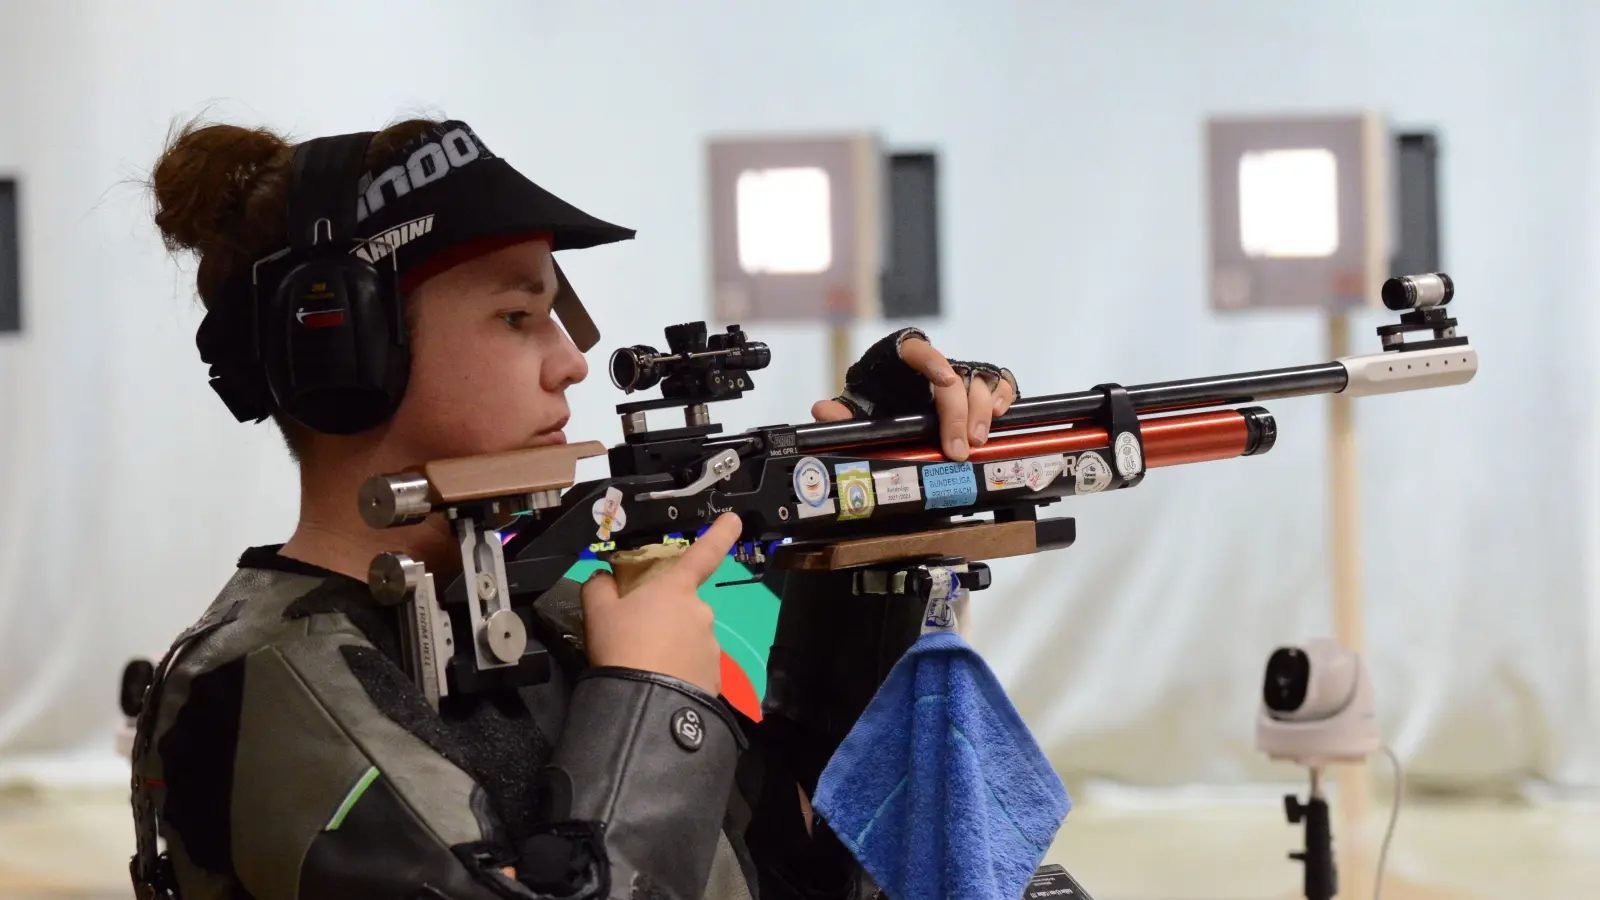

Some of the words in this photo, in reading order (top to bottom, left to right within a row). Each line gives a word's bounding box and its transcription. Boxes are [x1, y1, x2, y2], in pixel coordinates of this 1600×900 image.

[924, 463, 971, 477] BUNDESLIGA
[929, 476, 971, 488] BUNDESLIGA
[682, 710, 700, 740] 10.9
